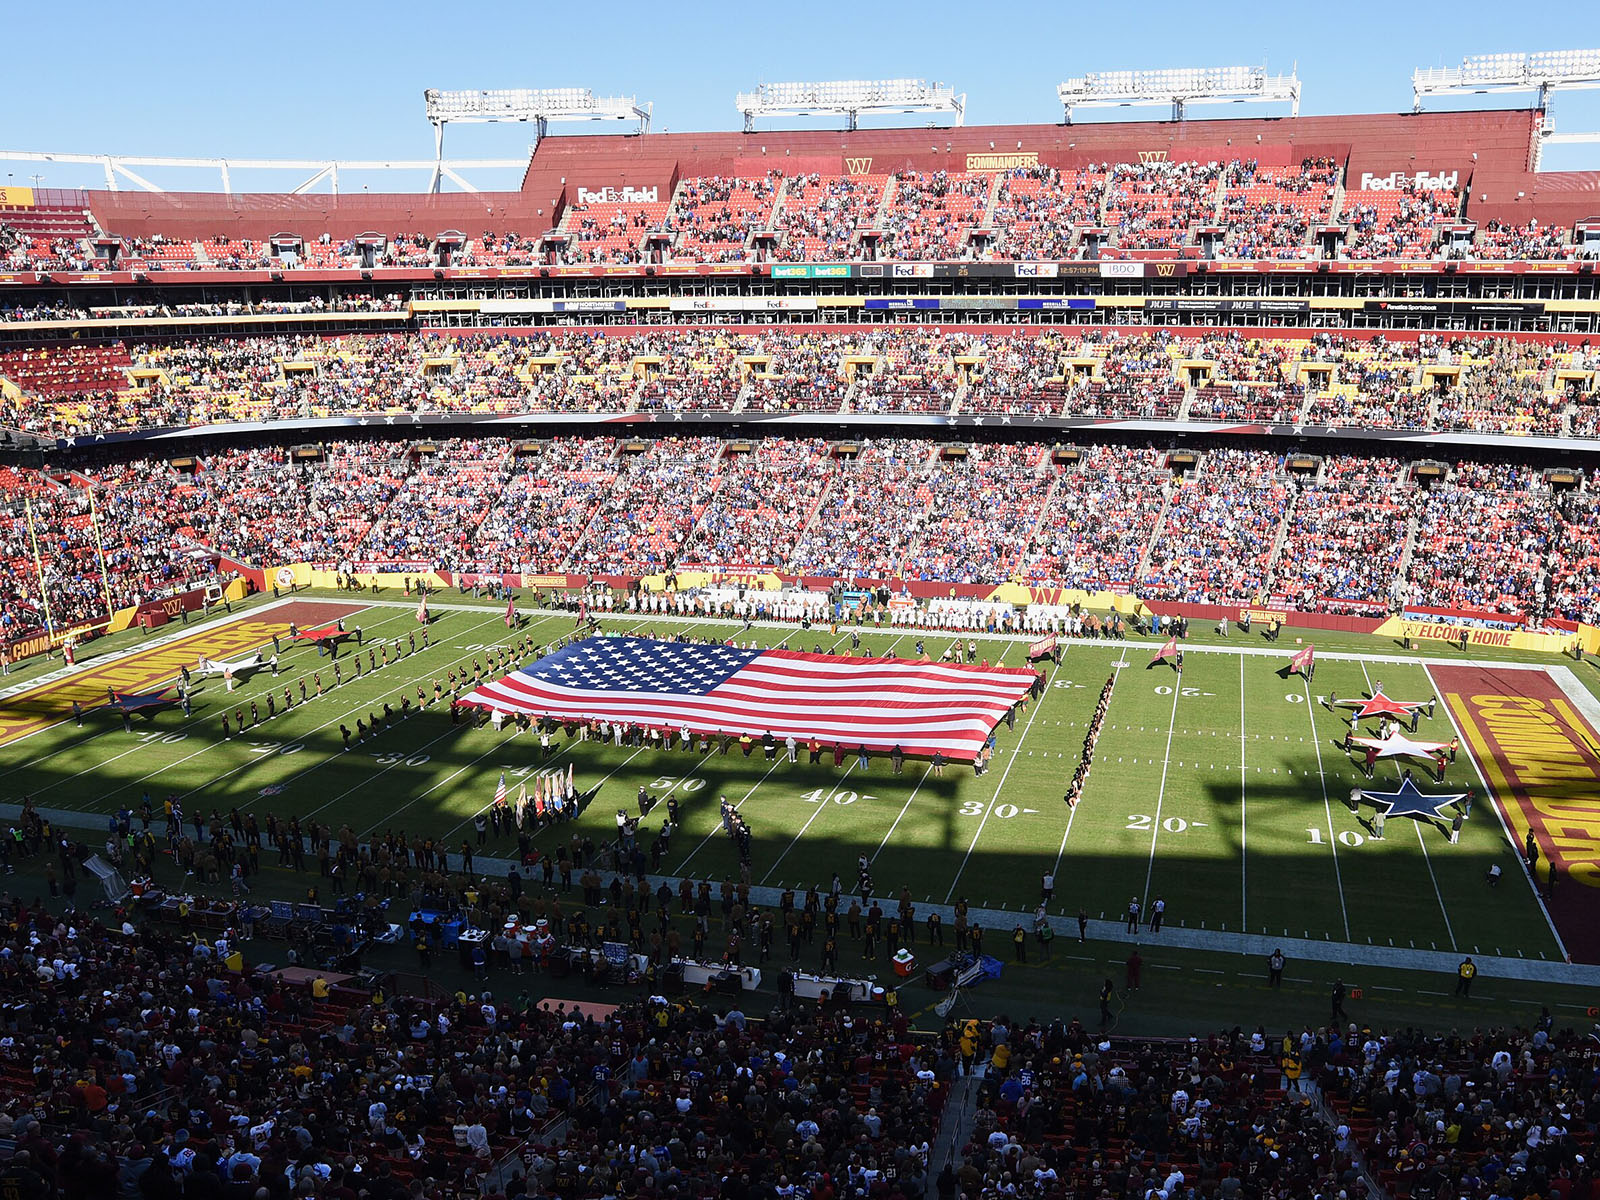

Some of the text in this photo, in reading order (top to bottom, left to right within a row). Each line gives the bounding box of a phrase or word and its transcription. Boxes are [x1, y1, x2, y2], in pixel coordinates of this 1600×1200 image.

[966, 156, 1038, 169] COMMANDERS
[578, 186, 658, 203] FedExField
[775, 267, 807, 276] bet365
[815, 267, 847, 275] bet365
[895, 265, 926, 275] FedEx
[1018, 265, 1050, 275] FedEx
[1112, 265, 1135, 273] BDO
[694, 301, 715, 309] FedEx
[1240, 611, 1287, 622] CMMANDERS
[1472, 631, 1512, 646] HOME
[0, 621, 291, 737] OMMANDERS
[649, 776, 707, 792] 50
[800, 788, 858, 805] 40
[958, 801, 1018, 818] 30
[1125, 814, 1187, 833] 20
[1305, 828, 1364, 847] 10
[595, 1071, 605, 1080] 21
[673, 1073, 681, 1081] 17
[1021, 1076, 1031, 1085] 26
[886, 1168, 896, 1178] 21
